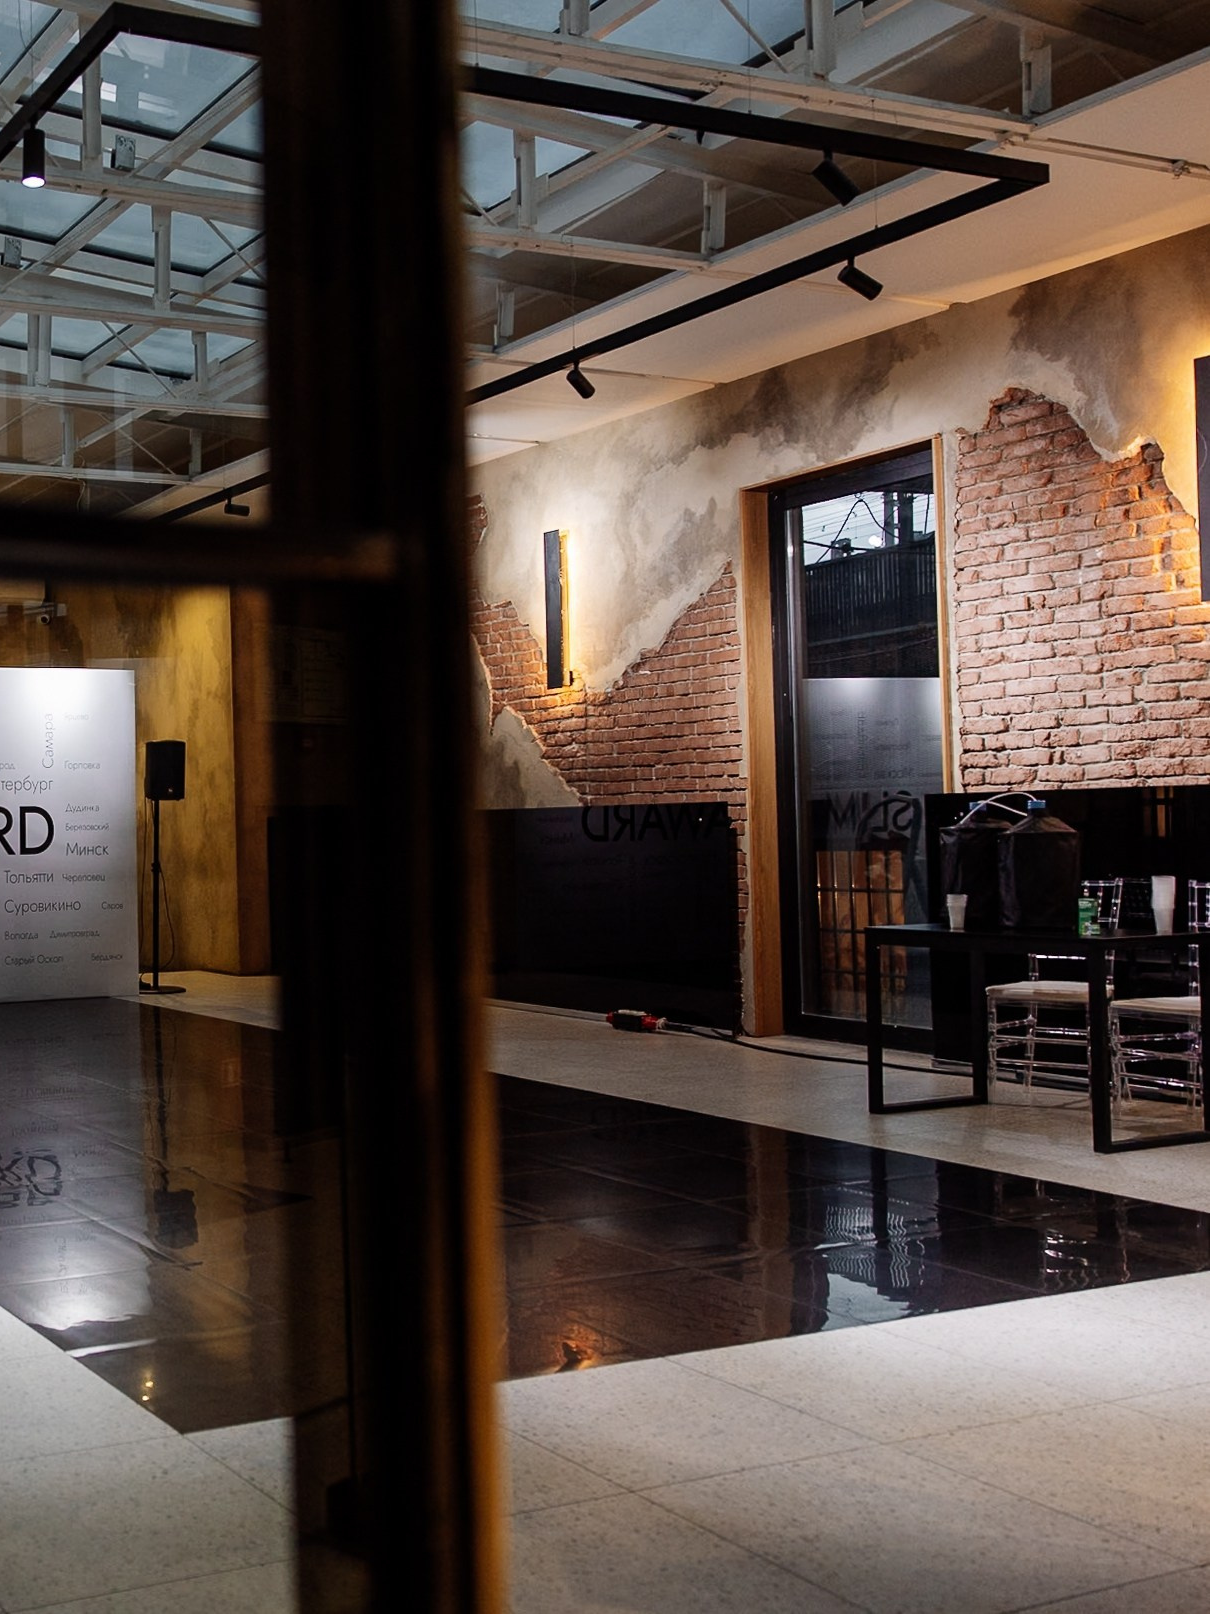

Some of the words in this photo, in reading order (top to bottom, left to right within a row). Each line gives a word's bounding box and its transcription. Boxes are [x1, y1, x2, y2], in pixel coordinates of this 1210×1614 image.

[42, 713, 56, 769] Самара
[65, 803, 100, 813] Дудинка
[66, 842, 110, 857] Минск
[4, 870, 54, 884] Тольятти
[4, 899, 82, 915] Суровикино
[4, 931, 39, 941] Вологда
[4, 955, 35, 966] Старый
